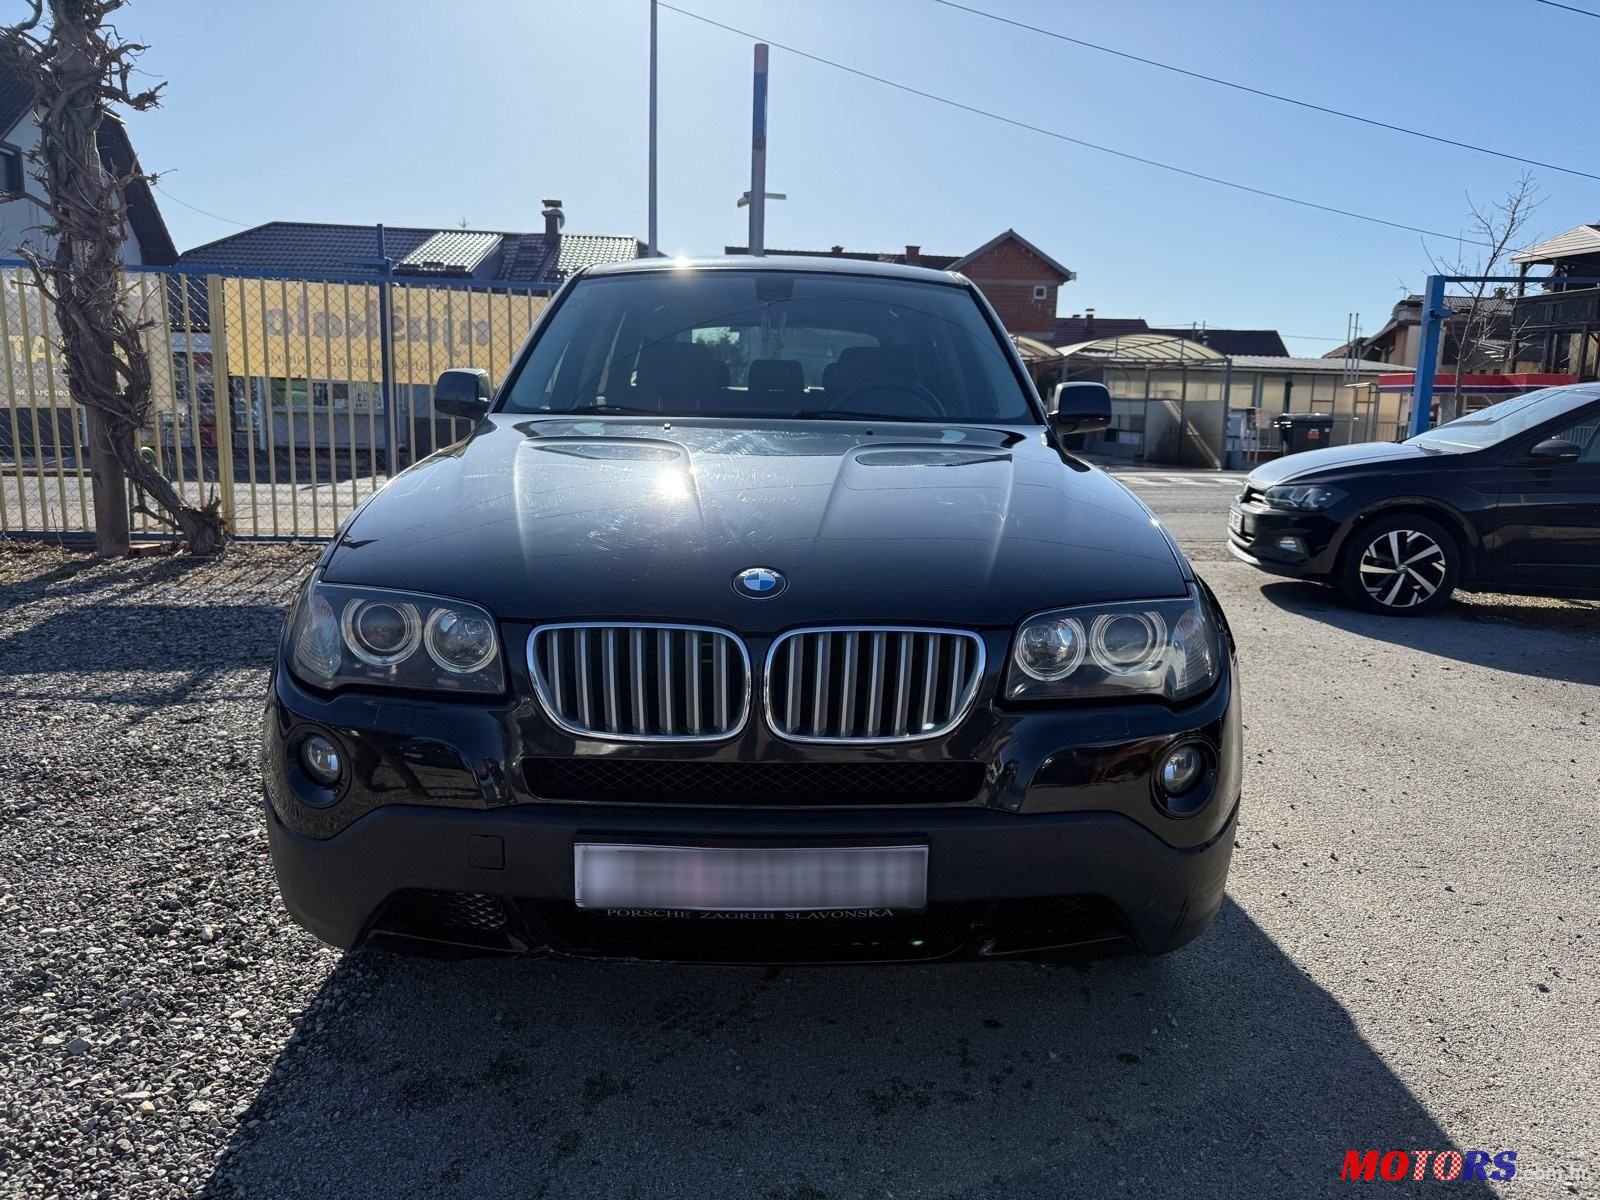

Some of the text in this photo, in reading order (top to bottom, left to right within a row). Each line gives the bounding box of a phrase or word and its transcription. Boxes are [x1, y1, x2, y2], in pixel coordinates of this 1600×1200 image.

[606, 908, 894, 920] PORSCHE ZAGREB SLAVONSKA
